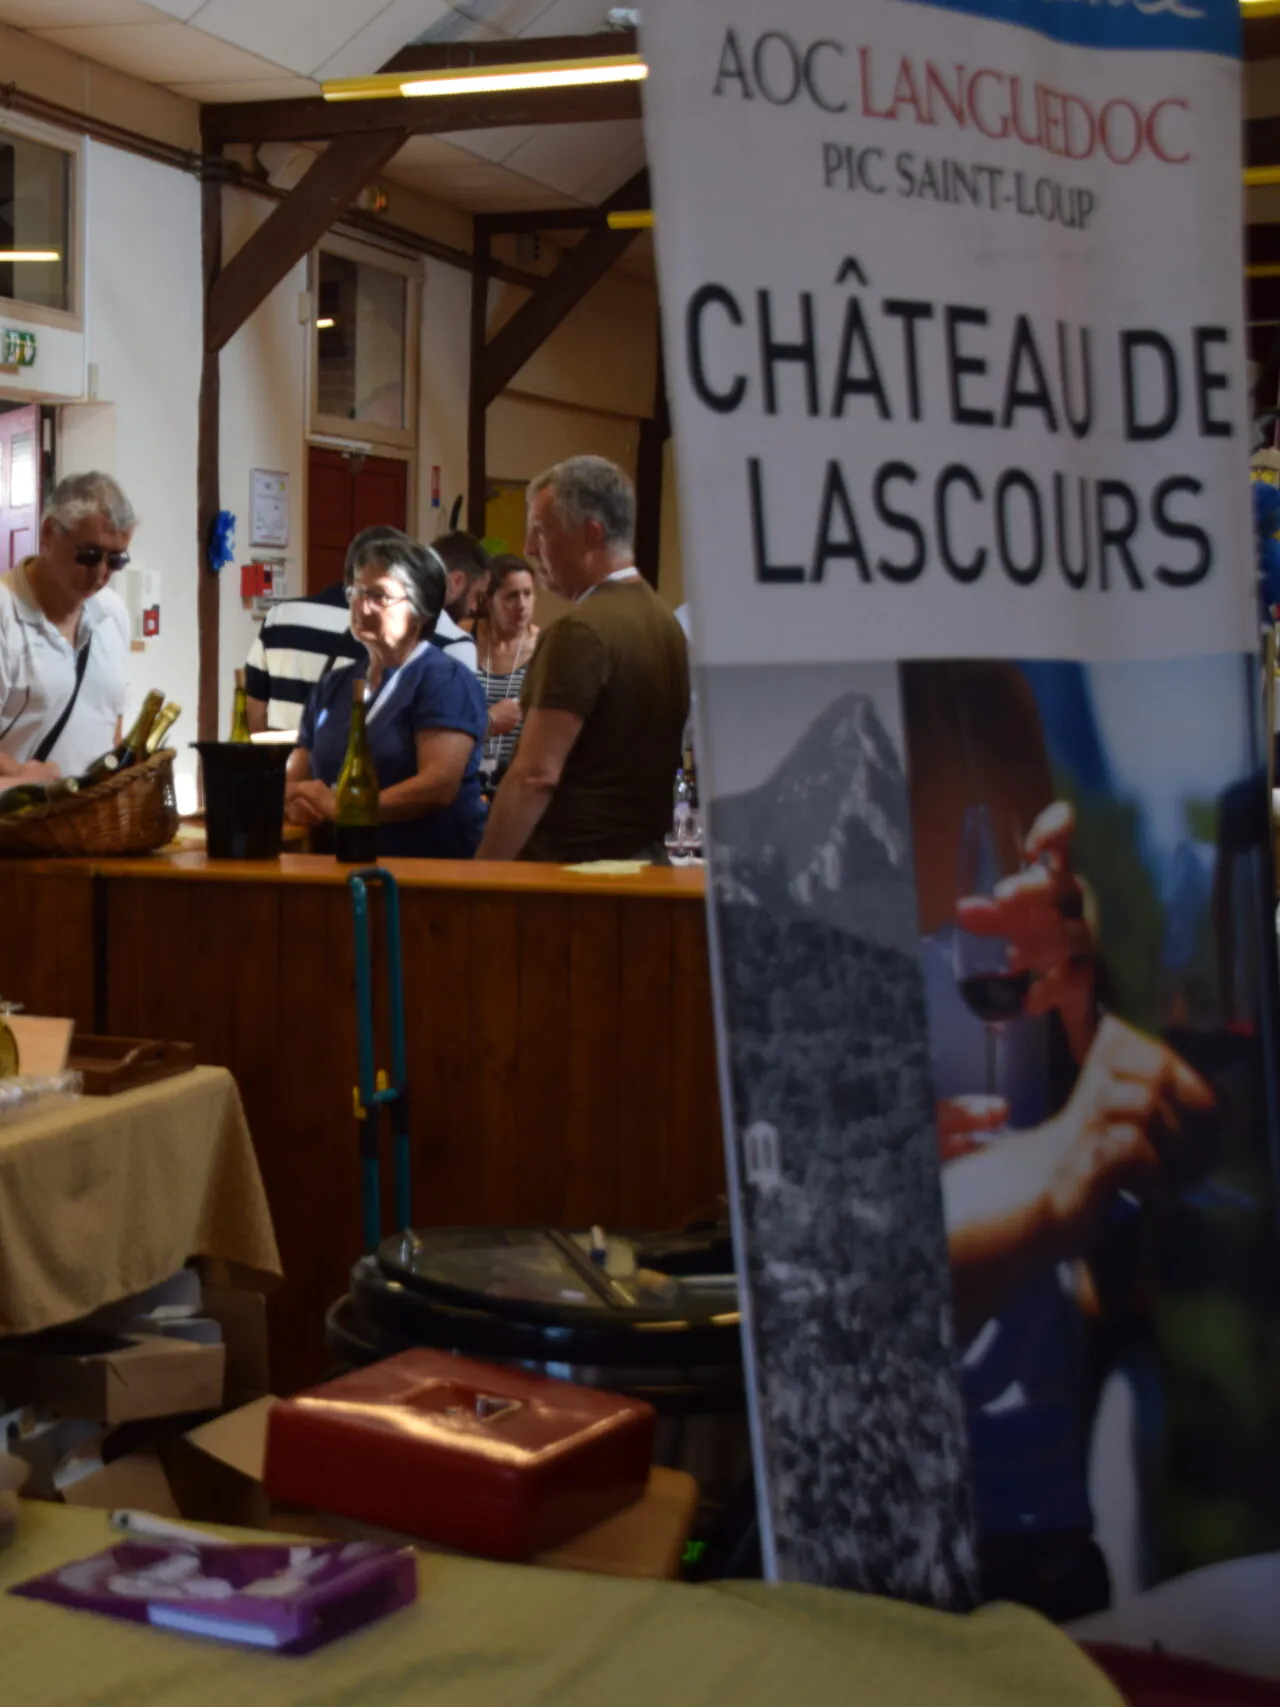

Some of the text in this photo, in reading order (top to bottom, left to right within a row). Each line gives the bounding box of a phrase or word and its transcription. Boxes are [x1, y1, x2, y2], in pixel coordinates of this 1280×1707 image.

[713, 26, 1191, 165] AOC LANGUEDOC
[824, 143, 1095, 230] PIC SAINT-LOUP
[685, 255, 1234, 442] CHÂTEAU DE
[748, 456, 1212, 591] LASCOURS
